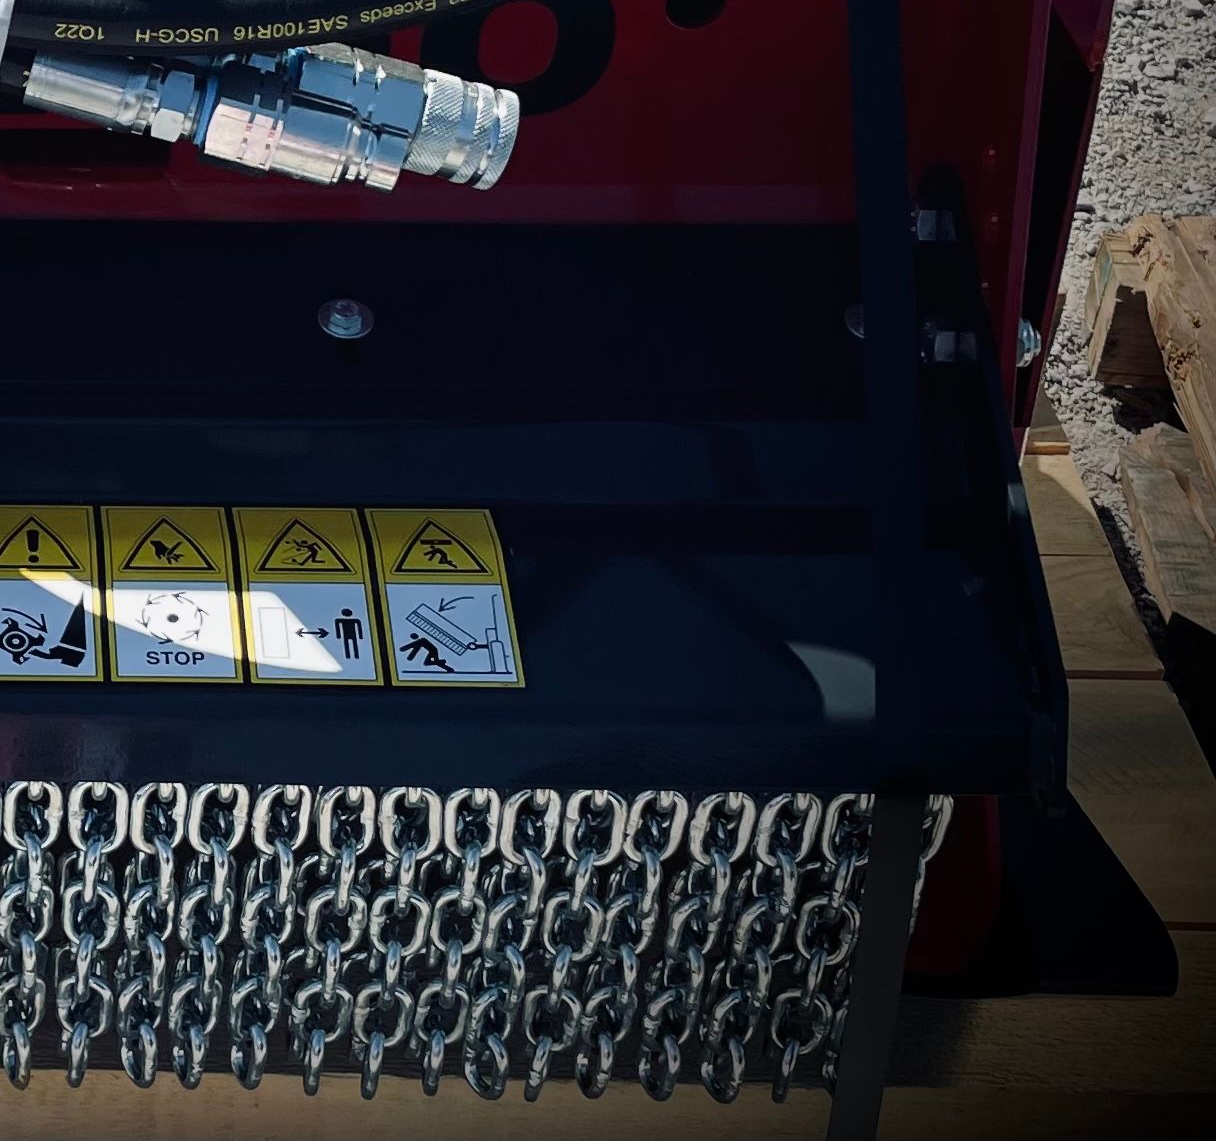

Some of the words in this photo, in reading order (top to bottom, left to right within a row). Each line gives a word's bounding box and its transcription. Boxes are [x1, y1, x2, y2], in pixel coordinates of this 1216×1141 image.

[53, 22, 105, 42] 1Q22
[135, 26, 220, 45] USCG-H
[233, 14, 350, 42] SAE100R16
[146, 651, 205, 666] STOP
